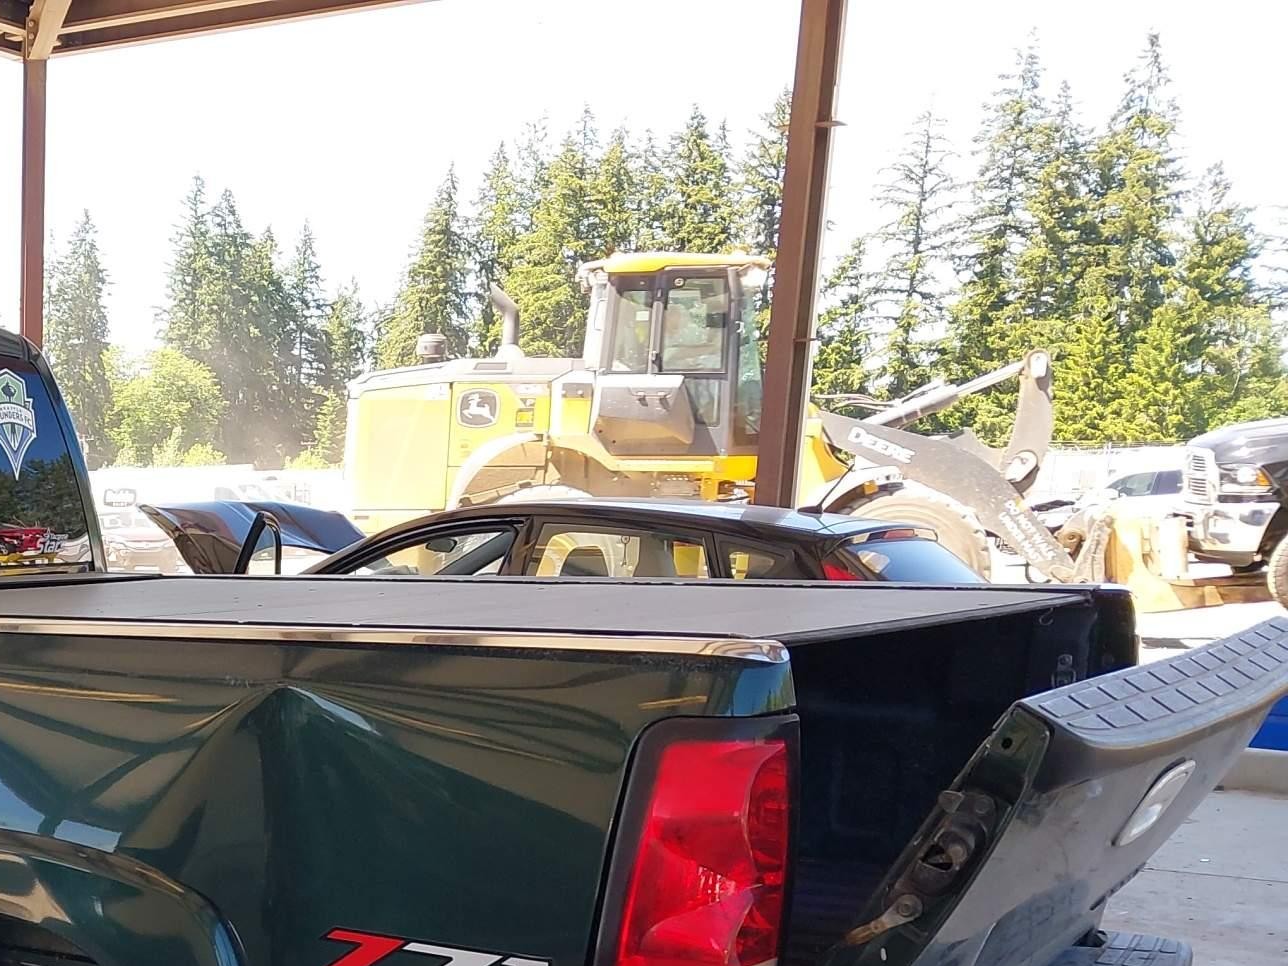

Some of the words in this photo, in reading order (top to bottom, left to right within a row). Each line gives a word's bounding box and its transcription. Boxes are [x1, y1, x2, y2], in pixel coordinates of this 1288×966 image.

[24, 415, 34, 428] FC
[847, 426, 916, 464] DEERE
[1004, 499, 1021, 515] DO
